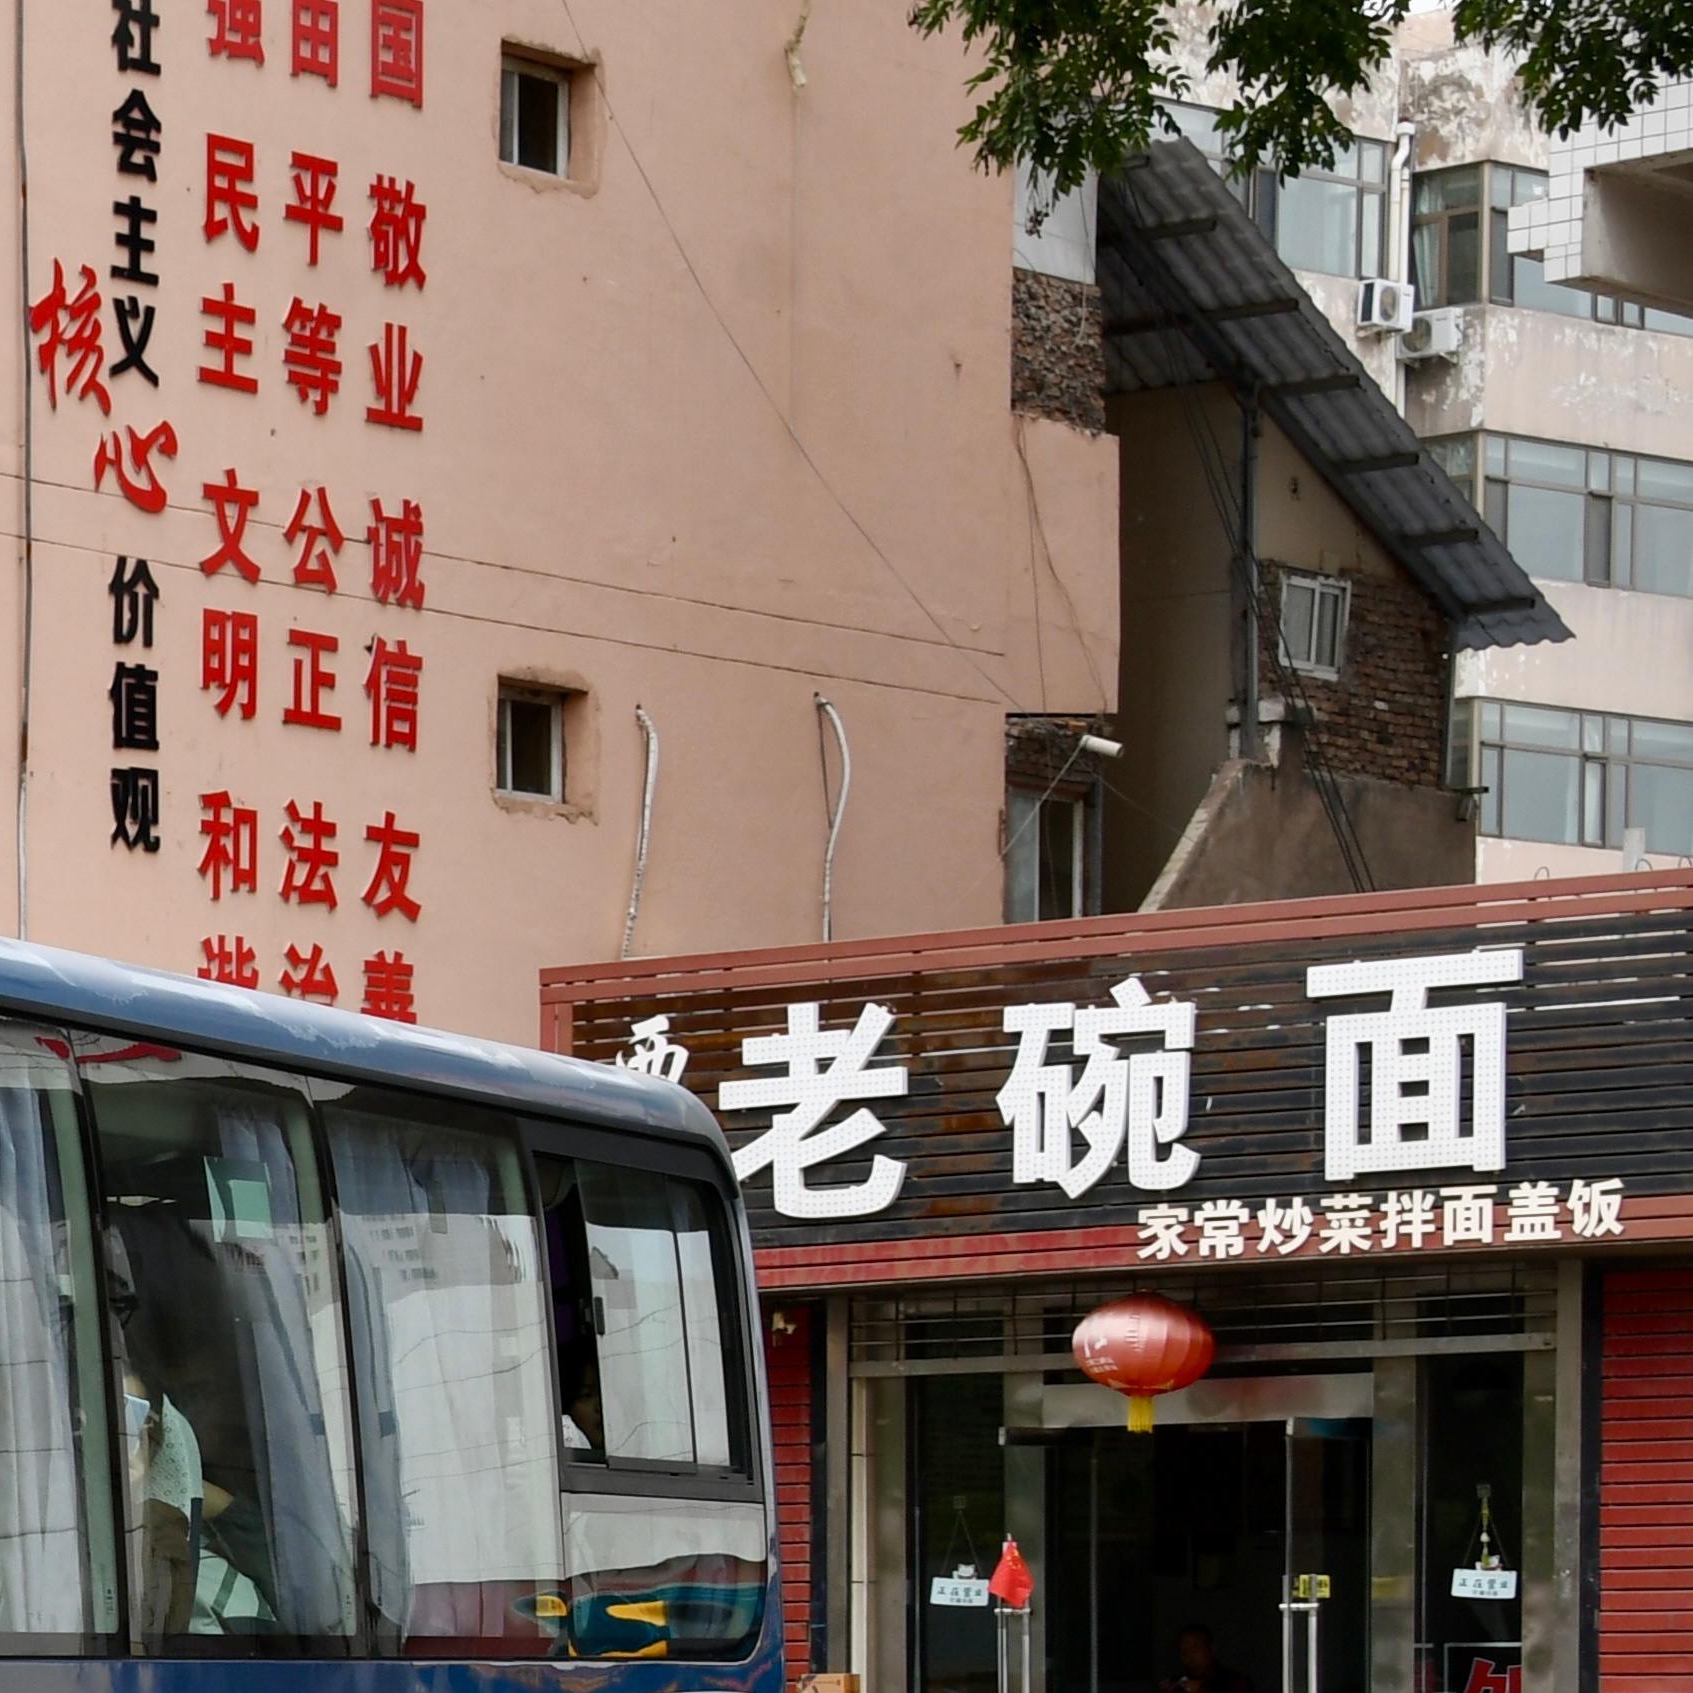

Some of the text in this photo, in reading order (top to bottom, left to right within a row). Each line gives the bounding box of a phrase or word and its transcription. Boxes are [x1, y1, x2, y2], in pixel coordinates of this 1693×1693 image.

[196, 132, 262, 394] 民主
[283, 150, 344, 416] 平等
[365, 173, 428, 433] 敬业
[29, 0, 179, 854] 社会主义 核心 价值观
[198, 468, 262, 721] 文明
[282, 487, 345, 732] 公正
[362, 497, 426, 753] 诚信
[718, 949, 1526, 1220] 老碗面
[1137, 1178, 1626, 1260] 家常炒菜拌面盖饭
